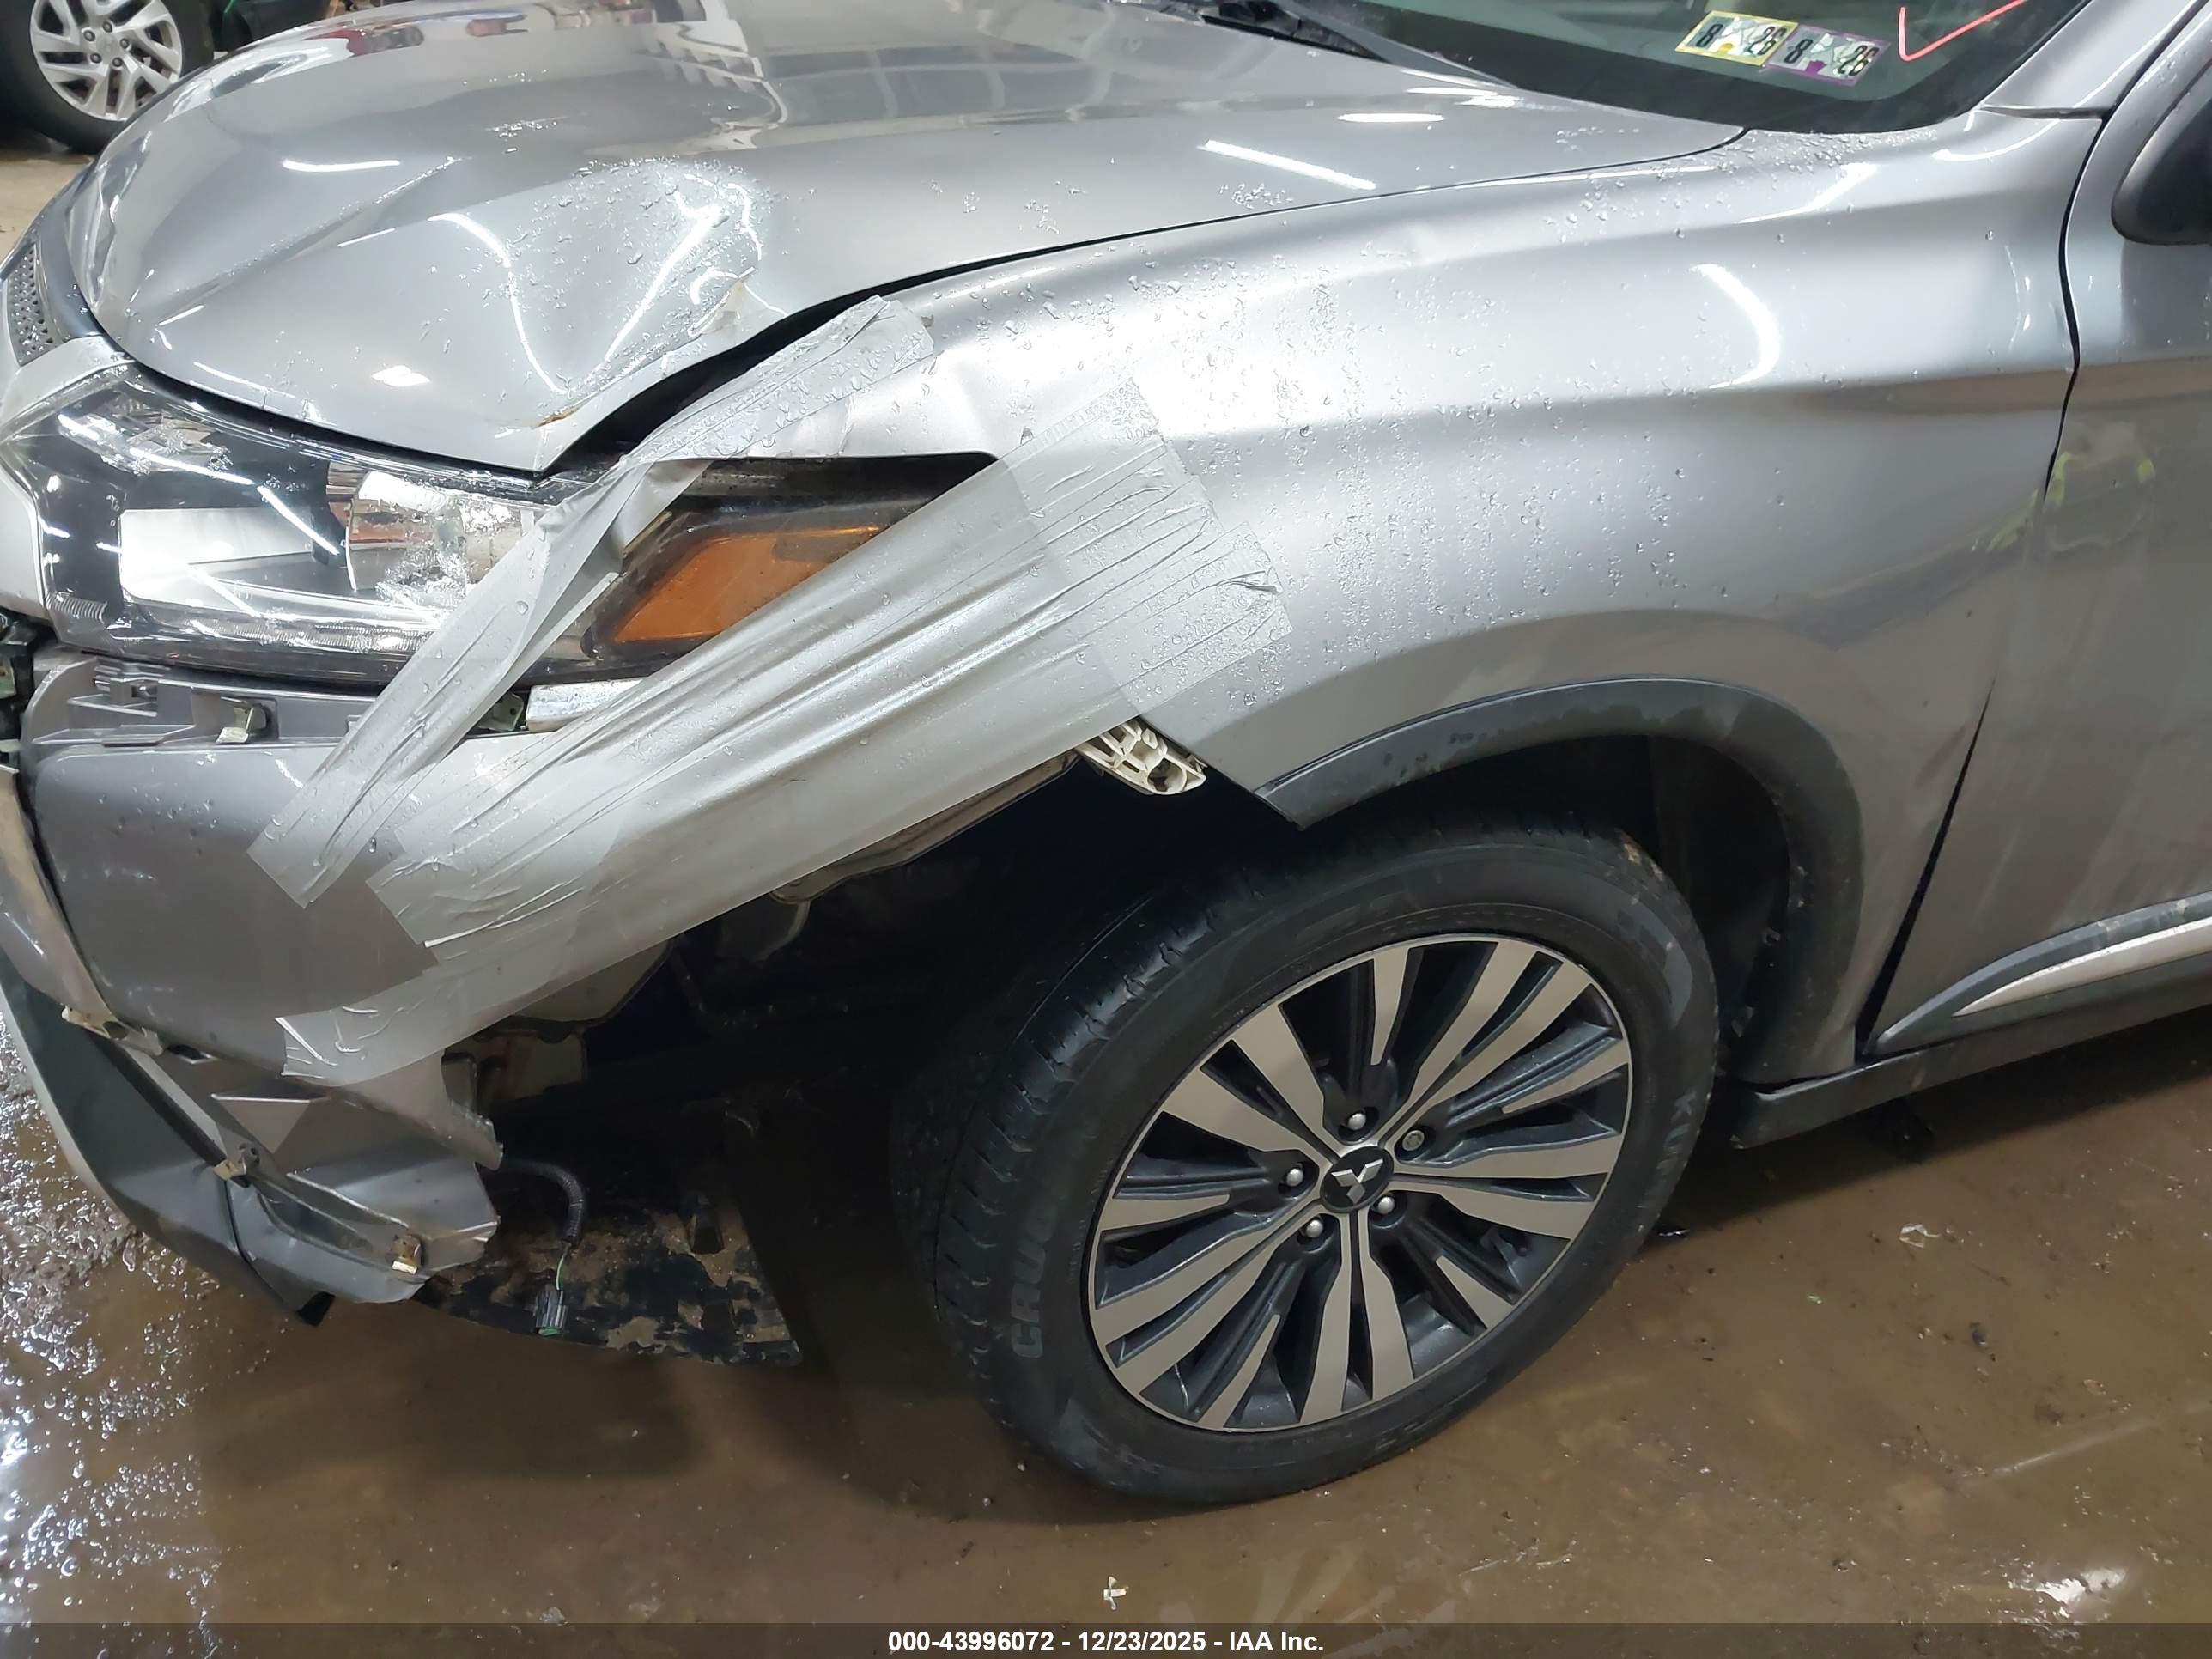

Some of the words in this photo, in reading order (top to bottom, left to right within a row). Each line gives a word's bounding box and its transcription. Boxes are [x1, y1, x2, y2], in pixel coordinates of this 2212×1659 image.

[1695, 23, 1723, 48] 8
[1784, 38, 1814, 64] 8
[1837, 45, 1880, 76] 26
